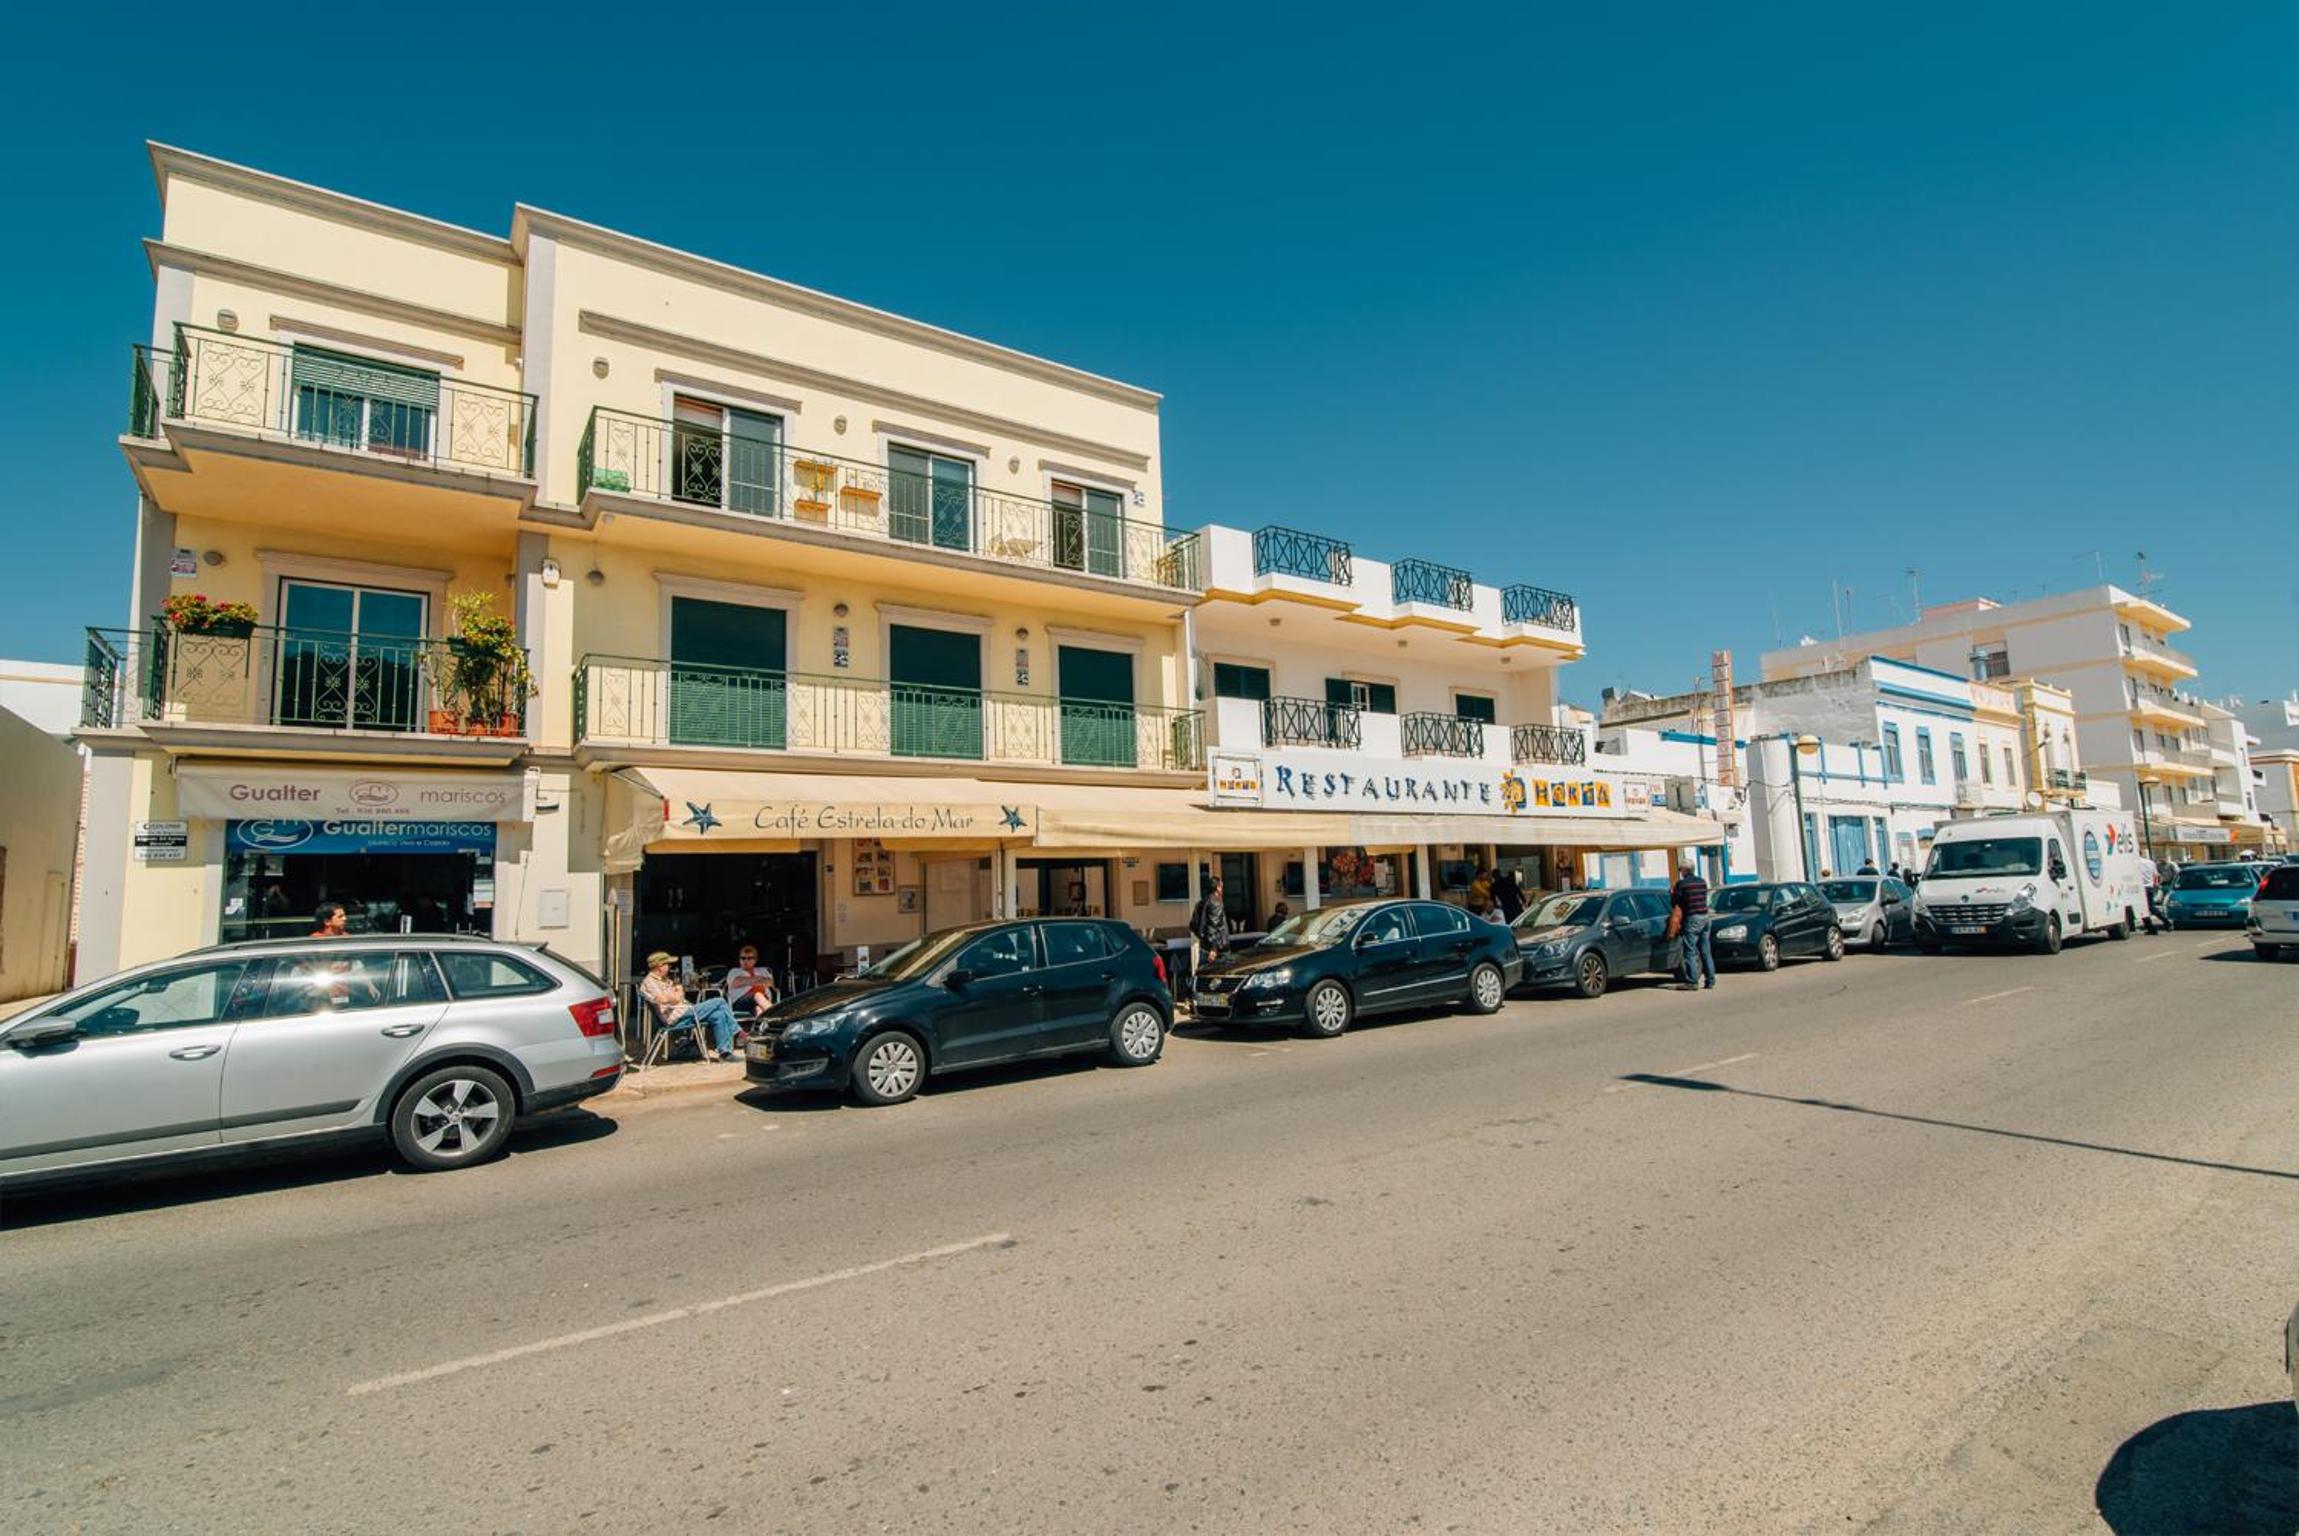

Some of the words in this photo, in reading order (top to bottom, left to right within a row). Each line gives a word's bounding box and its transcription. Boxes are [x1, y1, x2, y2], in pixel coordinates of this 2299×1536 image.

[229, 784, 321, 801] Gualter
[420, 787, 506, 805] mariscos
[1276, 764, 1492, 805] RESTAURANTE
[323, 819, 492, 837] Gualtermariscos
[754, 803, 809, 839] Café
[817, 805, 895, 830] Estrela
[901, 805, 925, 830] do
[931, 806, 974, 832] Mar
